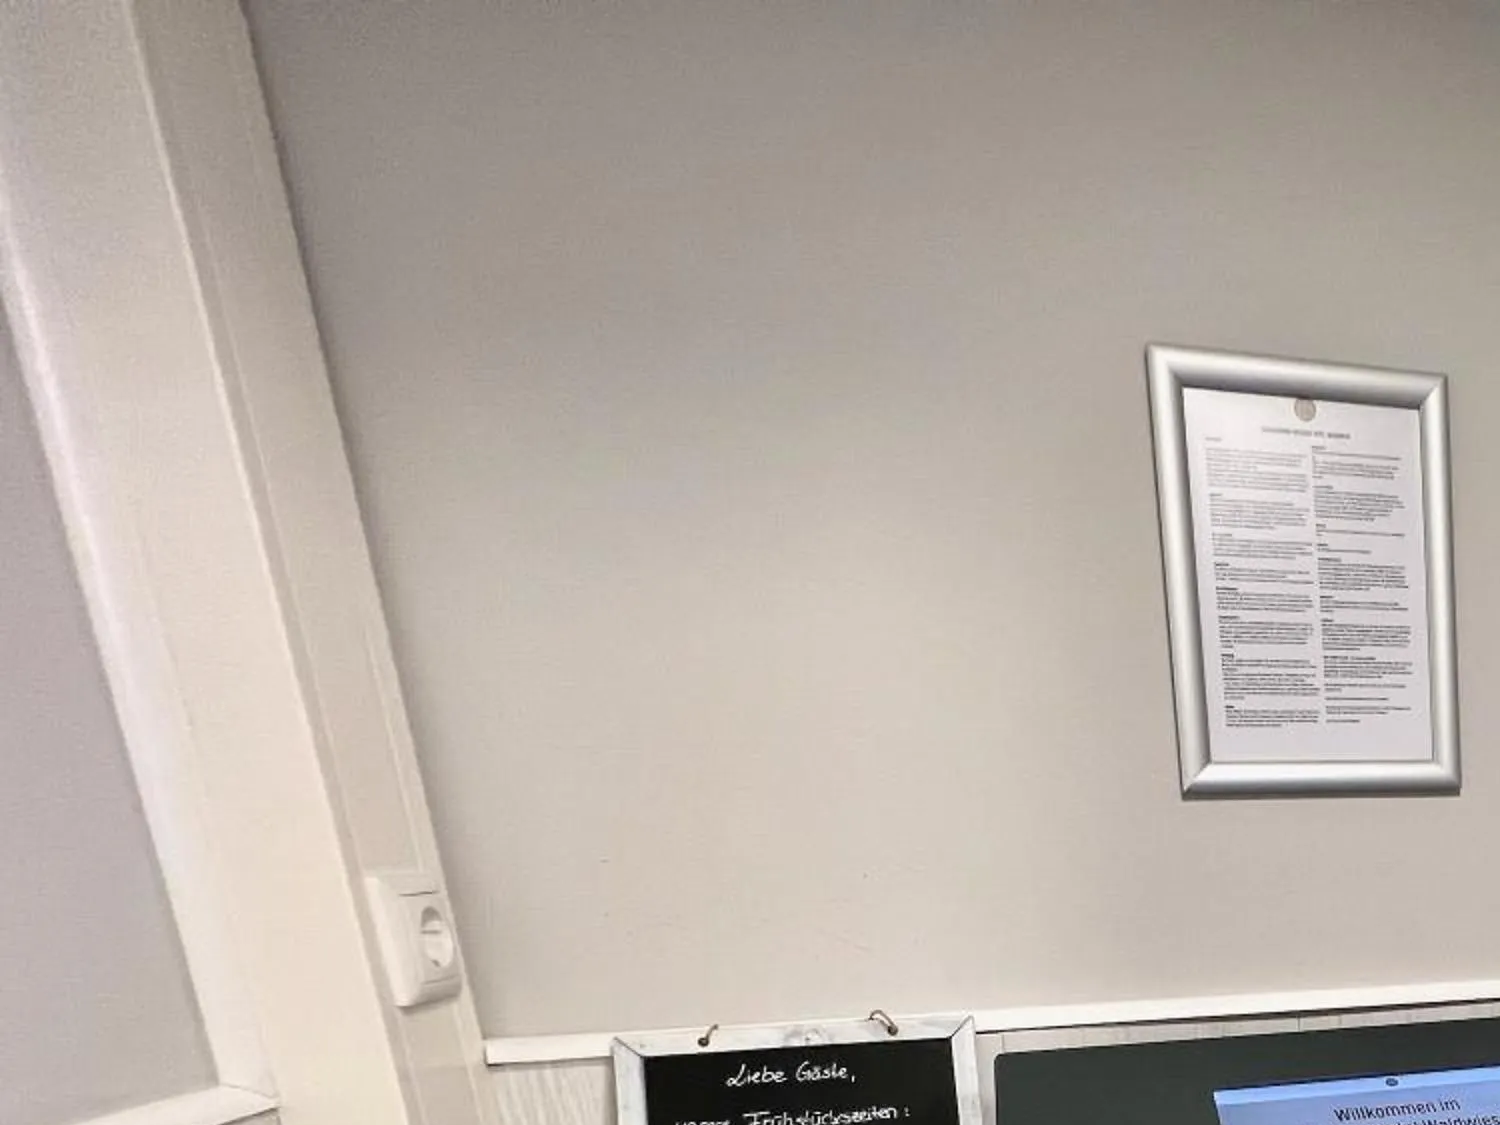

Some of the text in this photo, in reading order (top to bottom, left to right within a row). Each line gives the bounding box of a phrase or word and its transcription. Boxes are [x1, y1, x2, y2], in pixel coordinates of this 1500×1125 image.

[726, 1063, 787, 1087] Liebe
[1333, 1097, 1461, 1122] Willkommen im
